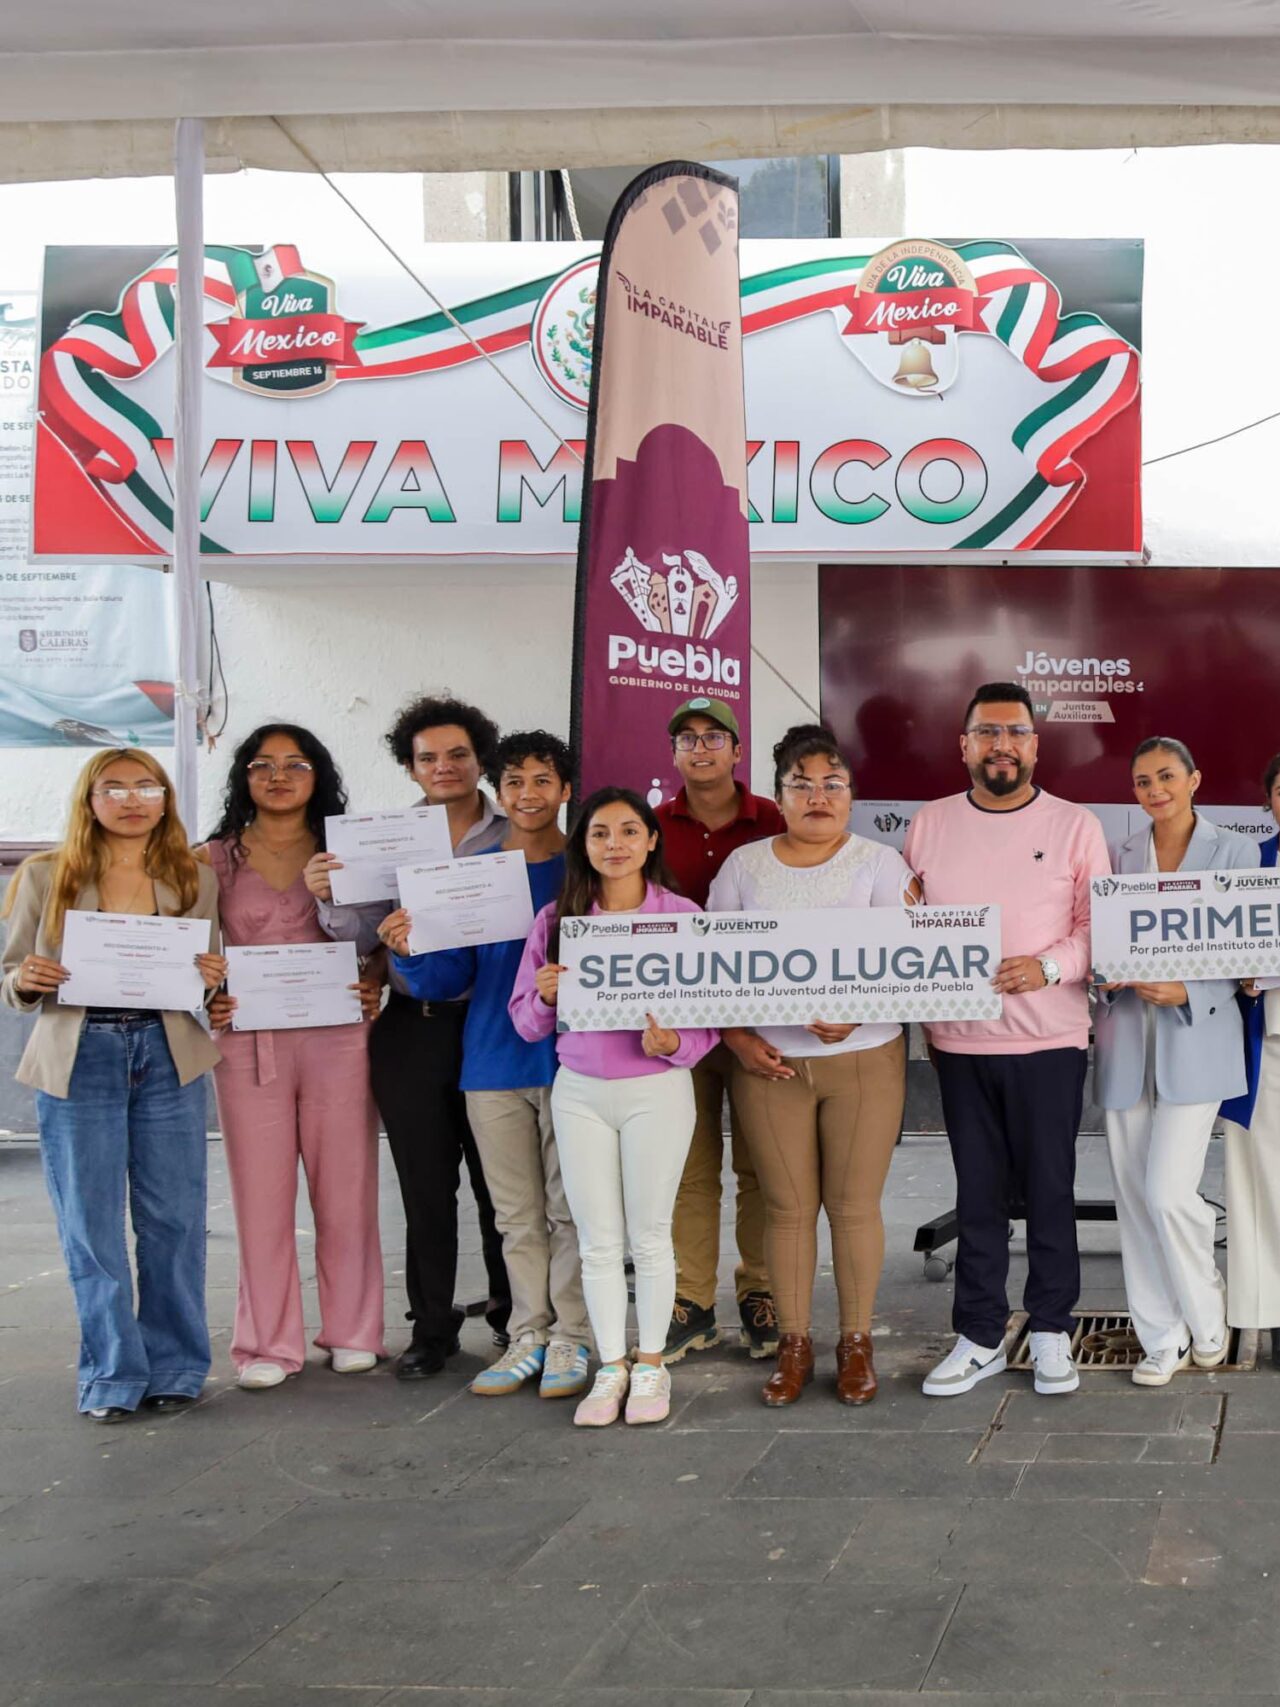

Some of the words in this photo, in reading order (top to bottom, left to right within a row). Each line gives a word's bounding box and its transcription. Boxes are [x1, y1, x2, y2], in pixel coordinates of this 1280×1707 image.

[867, 274, 879, 289] DIA
[875, 260, 888, 276] DE
[886, 252, 899, 265] LA
[900, 245, 966, 285] INDEPENDENCIA
[887, 265, 944, 290] Viva
[261, 293, 313, 317] Viva
[633, 285, 652, 299] LA
[659, 296, 718, 330] CAPITAL
[865, 297, 962, 329] Mexico
[627, 294, 729, 350] IMPARABLE
[229, 325, 342, 358] Mexico
[252, 367, 312, 380] SEPTIEMBRE
[314, 366, 322, 375] 16
[152, 438, 457, 523] VIVA
[497, 437, 988, 525] MICO
[22, 572, 77, 581] SEPTIEMBRE
[40, 638, 89, 648] CALERAS
[608, 634, 740, 686] Puebla
[1016, 651, 1131, 676] Jóvenes
[608, 675, 672, 690] GOBIERNO
[674, 682, 689, 692] DE
[692, 685, 705, 694] LA
[707, 687, 740, 700] CIUDAD
[1021, 675, 1135, 697] imparables
[1035, 704, 1047, 712] EN
[1053, 711, 1103, 720] Auxiliares
[1062, 703, 1096, 711] Juntas
[1121, 881, 1156, 892] Puebla
[911, 917, 986, 929] IMPARABLE
[933, 910, 980, 918] CAPITAL
[591, 923, 630, 934] Puebla
[713, 920, 778, 931] JUVENTUD
[1130, 945, 1149, 955] Por
[1152, 944, 1183, 956] parte
[1186, 943, 1204, 953] del
[1206, 941, 1255, 952] Instituto
[1258, 939, 1273, 949] de
[578, 949, 818, 989] SEGUNDO
[832, 944, 990, 982] LUGAR
[596, 991, 618, 1002] Por
[621, 990, 655, 1003] parte
[658, 988, 676, 999] del
[680, 988, 733, 1000] Instituto
[735, 987, 751, 998] de
[753, 987, 765, 997] la
[768, 985, 826, 997] Juventud
[829, 984, 848, 995] del
[851, 983, 911, 996] Municipio
[913, 982, 929, 993] de
[932, 982, 974, 992] Puebla
